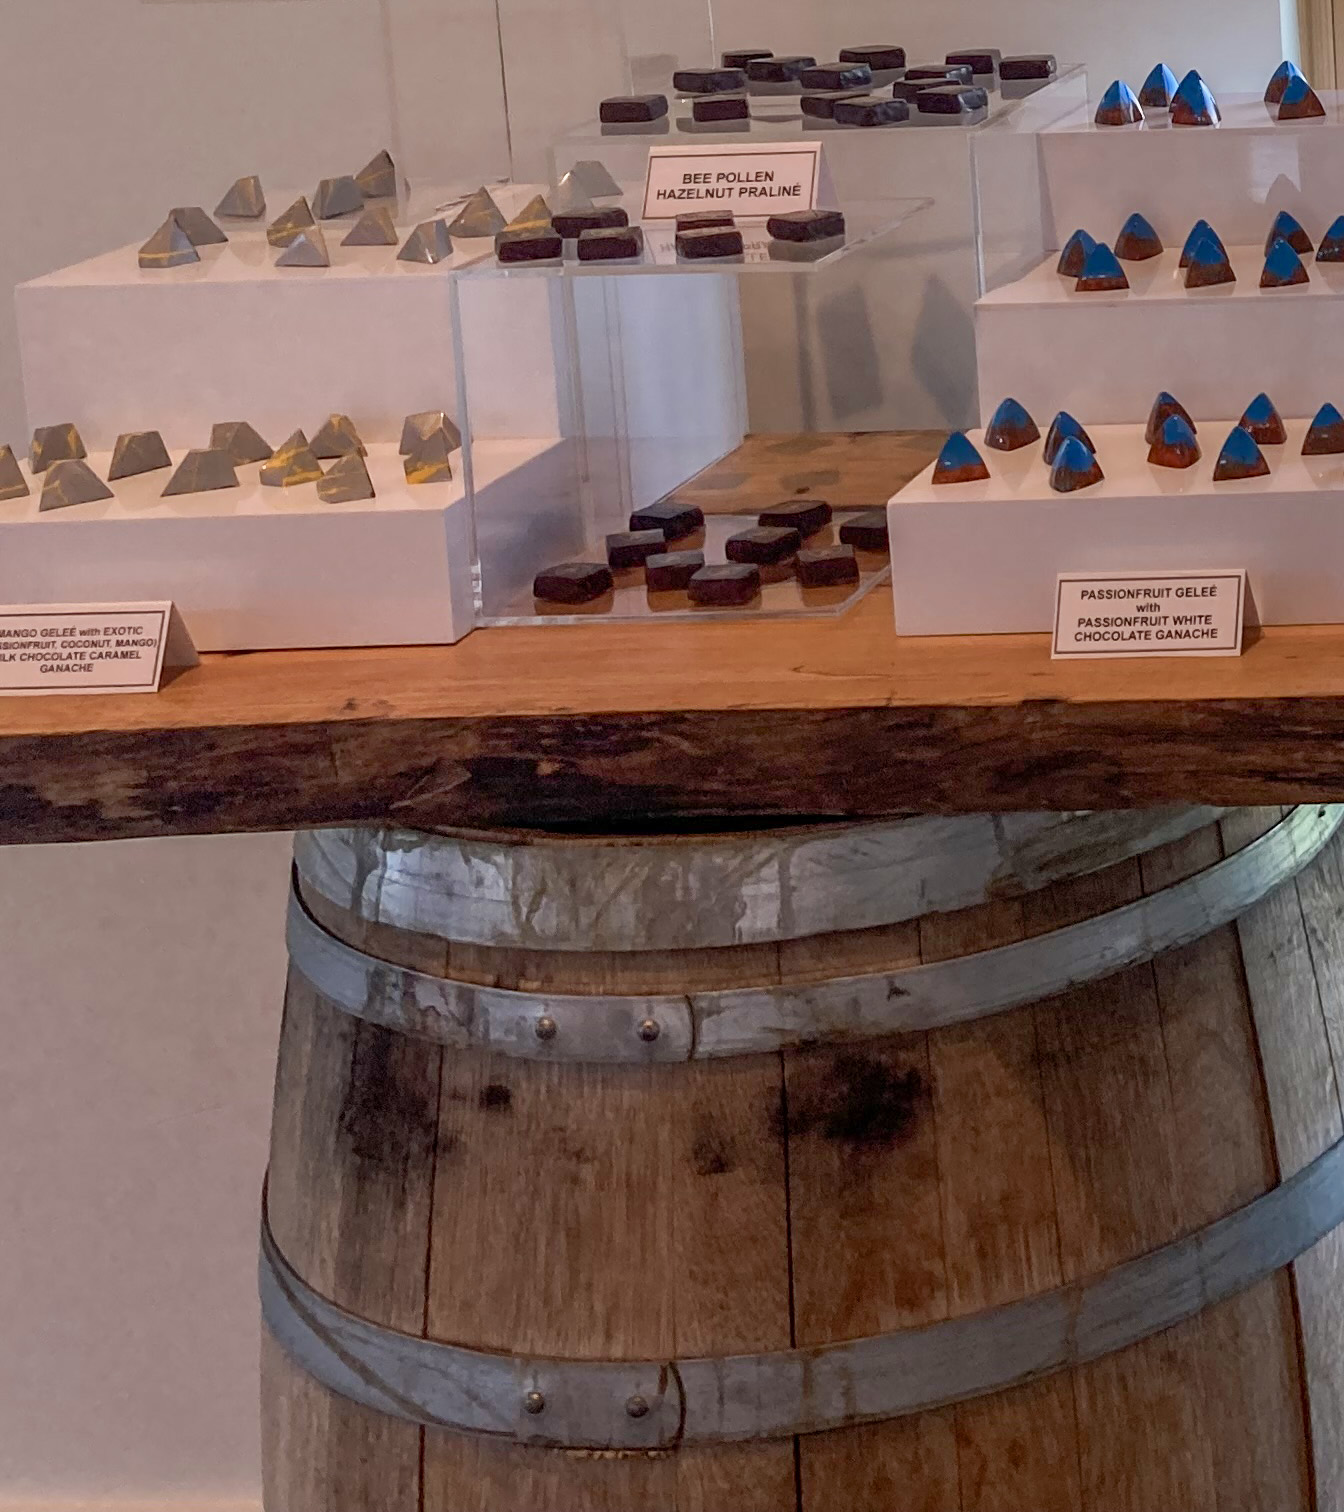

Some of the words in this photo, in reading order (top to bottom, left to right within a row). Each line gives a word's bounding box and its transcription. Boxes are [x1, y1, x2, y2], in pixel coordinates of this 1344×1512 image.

[682, 173, 712, 184] BEE
[716, 171, 774, 183] POLLEN
[656, 188, 735, 200] HAZELNUT
[738, 183, 801, 198] PRALINÉ
[1081, 588, 1173, 600] PASSIONFRUIT
[1175, 585, 1217, 597] GELEÉ
[1136, 603, 1160, 613] with
[1078, 616, 1169, 628] PASSIONFRUIT
[1172, 615, 1213, 625] WHITE
[40, 625, 76, 637] GELEÉ
[79, 628, 100, 636] with
[103, 626, 144, 636] EXOTIC
[1074, 630, 1152, 642] CHOCOLATE
[1155, 628, 1218, 640] GANACHE
[61, 639, 112, 649] COCONUT,
[115, 638, 157, 648] MANGO)
[20, 651, 86, 661] CHOCOLATE
[89, 650, 142, 660] CARAMEL
[40, 663, 94, 673] GANACHE
